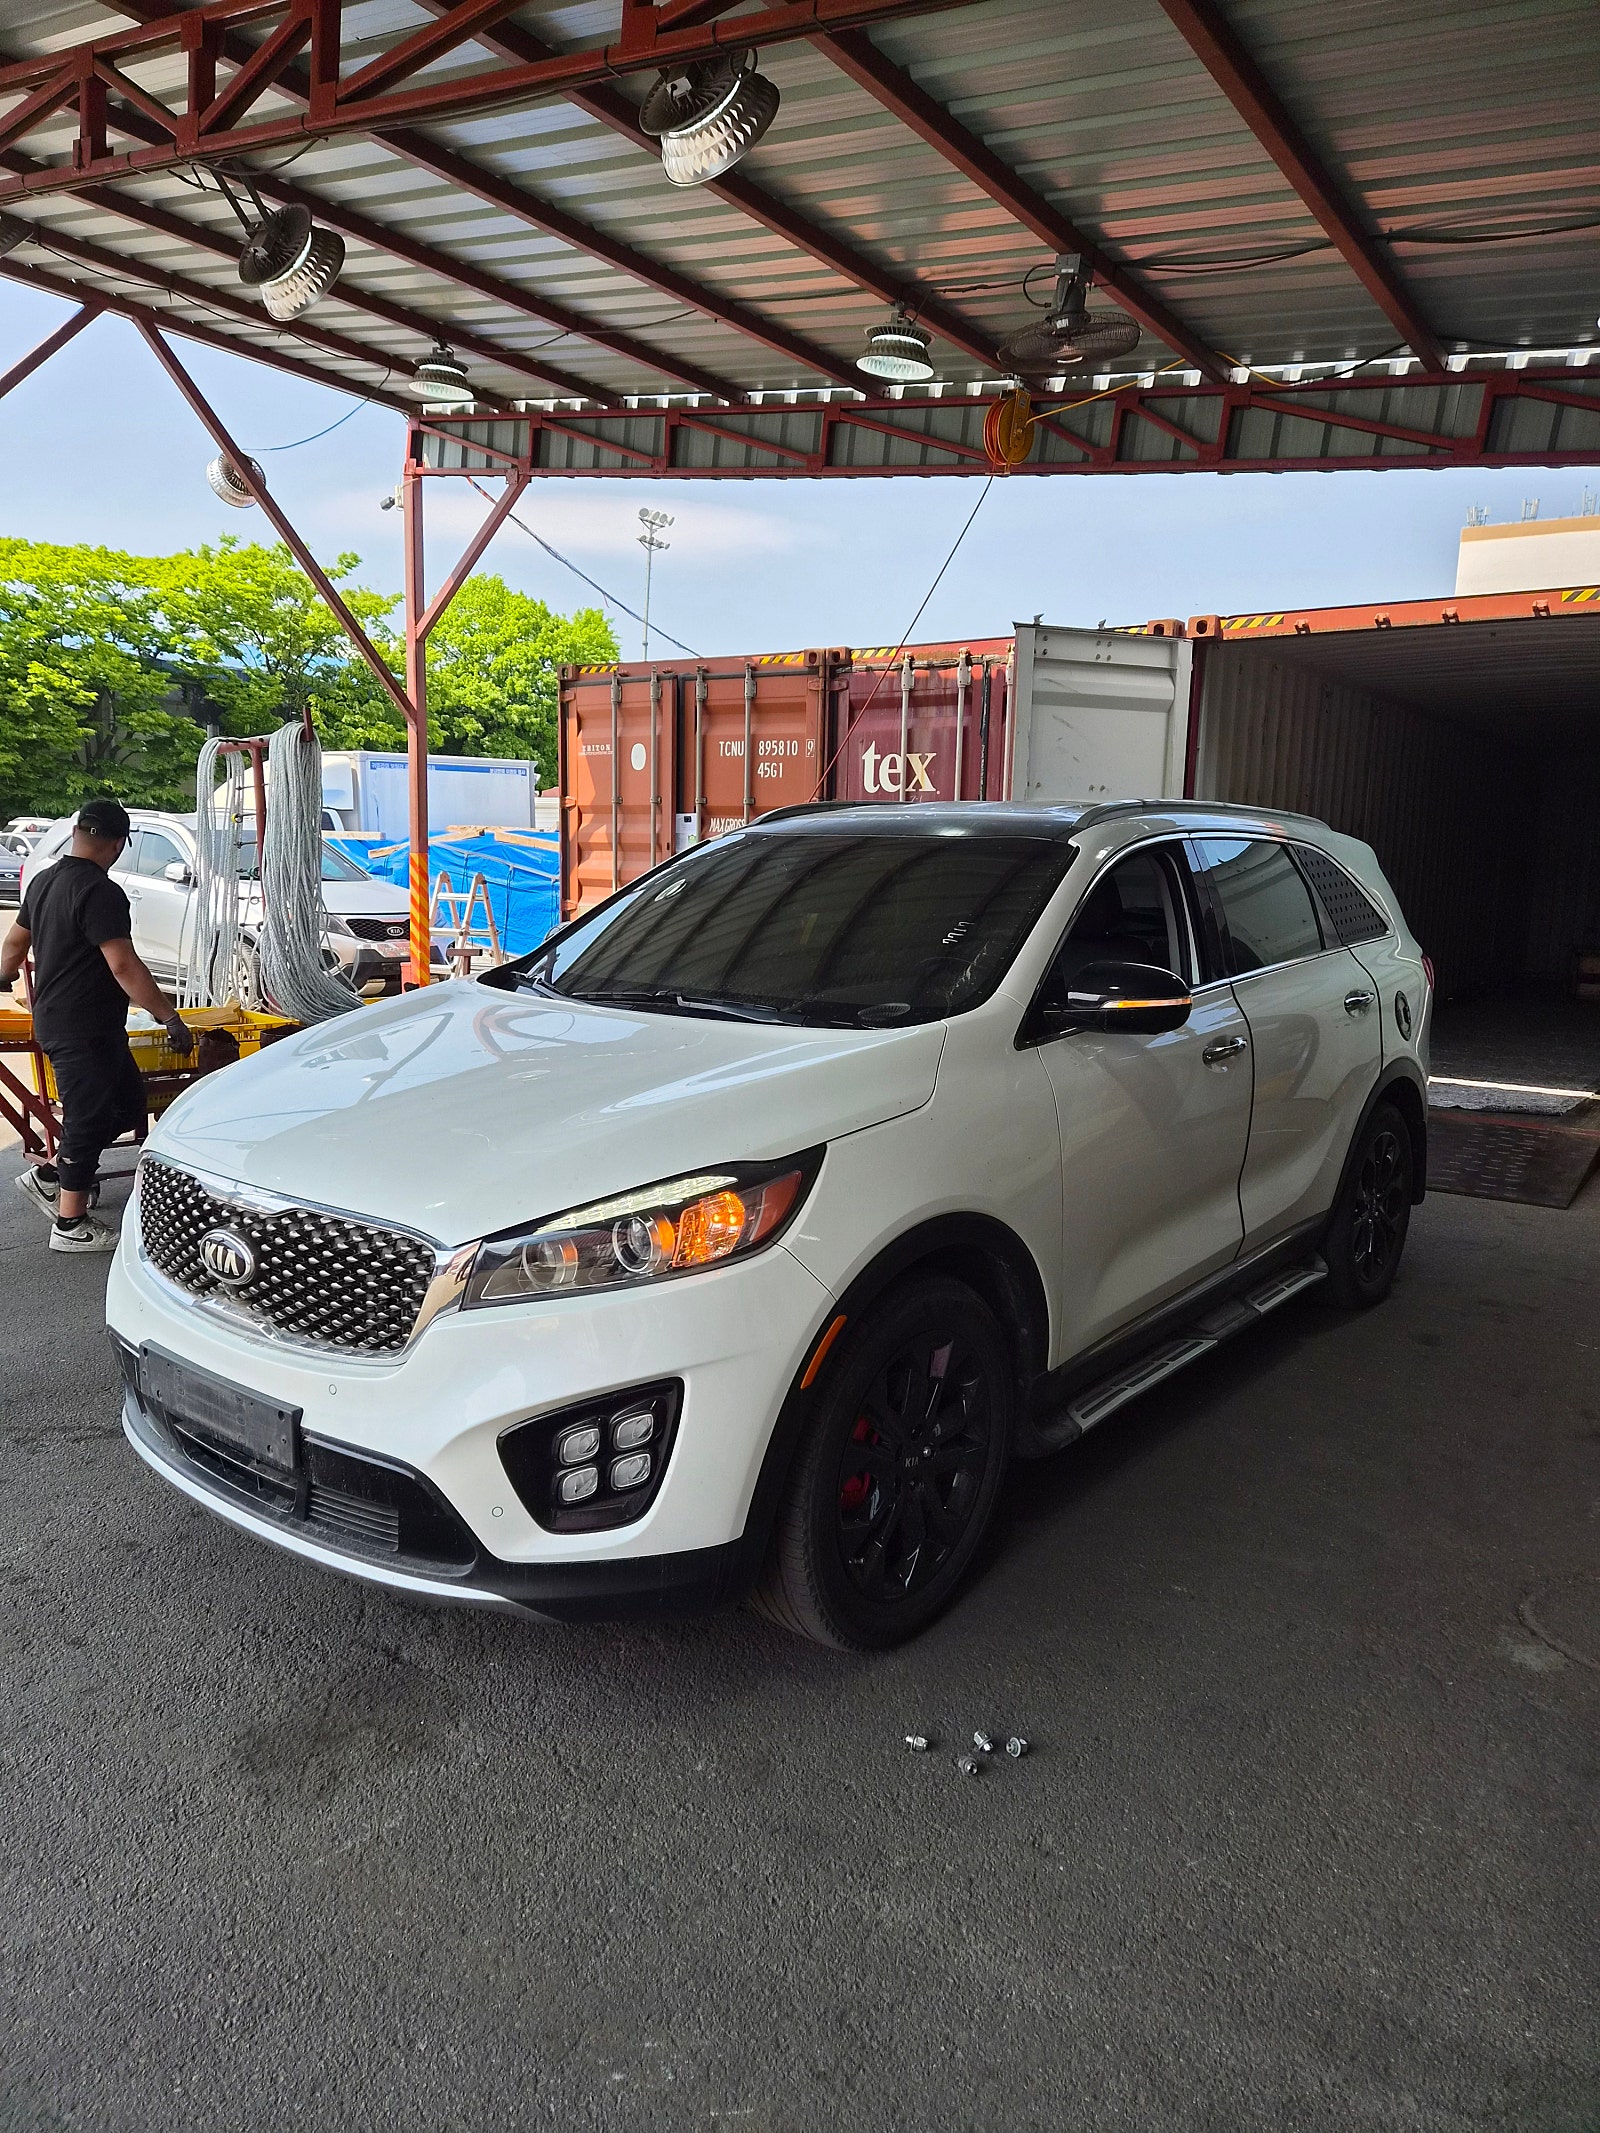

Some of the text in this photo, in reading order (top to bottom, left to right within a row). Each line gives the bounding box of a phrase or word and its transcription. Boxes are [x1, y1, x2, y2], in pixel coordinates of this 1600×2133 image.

[719, 740, 814, 756] TCNU 895810 9
[757, 762, 783, 778] 45G1
[861, 740, 937, 793] tex
[709, 817, 725, 833] MAX
[204, 1241, 240, 1276] KIA
[905, 1456, 919, 1468] KIA
